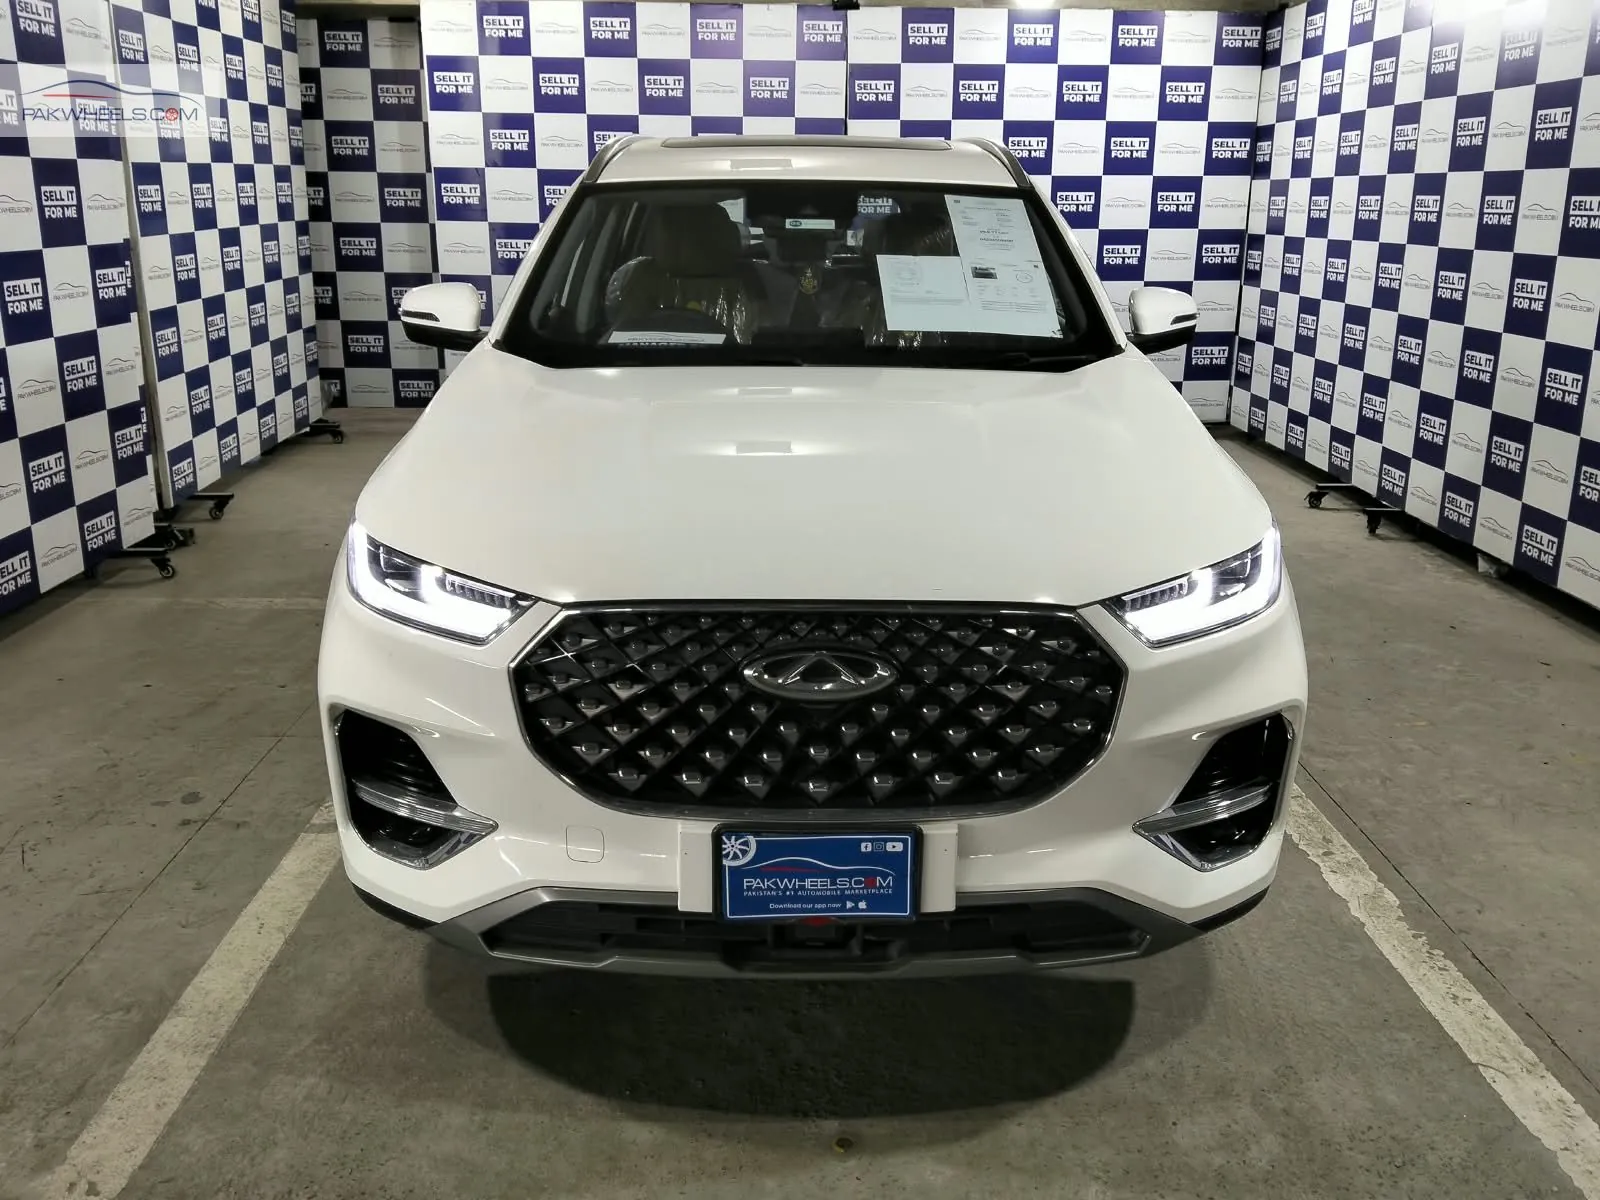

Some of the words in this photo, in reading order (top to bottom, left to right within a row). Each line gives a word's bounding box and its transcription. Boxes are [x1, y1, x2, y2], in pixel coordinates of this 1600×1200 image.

[120, 33, 136, 46] SELL
[136, 37, 142, 47] IT
[121, 47, 135, 60] FOR
[135, 50, 145, 62] ME
[178, 47, 191, 57] SELL
[191, 49, 196, 58] IT
[180, 60, 191, 70] FOR
[191, 61, 200, 71] ME
[1537, 113, 1559, 124] SELL
[1560, 111, 1570, 123] IT
[1395, 128, 1410, 137] SELL
[1410, 127, 1417, 136] IT
[1458, 122, 1476, 132] SELL
[1477, 121, 1485, 131] IT
[1456, 136, 1471, 146] FOR
[1471, 135, 1483, 145] ME
[1534, 129, 1553, 141] FOR
[1554, 127, 1569, 139] ME
[1393, 142, 1406, 151] FOR
[1406, 141, 1416, 151] ME
[43, 190, 65, 201] SELL
[66, 191, 74, 201] IT
[139, 189, 153, 198] SELL
[153, 188, 159, 198] IT
[140, 202, 153, 213] FOR
[152, 202, 162, 212] ME
[1361, 199, 1373, 207] SELL
[1374, 199, 1380, 207] IT
[1485, 199, 1504, 209] SELL
[1505, 200, 1514, 210] IT
[44, 207, 63, 218] FOR
[63, 206, 77, 217] ME
[1482, 214, 1498, 224] FOR
[1498, 214, 1512, 226] ME
[98, 272, 116, 283] SELL
[117, 271, 124, 282] IT
[5, 284, 30, 297] SELL
[31, 282, 40, 294] IT
[99, 287, 114, 300] FOR
[115, 286, 127, 297] ME
[1515, 282, 1536, 294] SELL
[1537, 285, 1546, 296] IT
[7, 301, 27, 314] FOR
[28, 298, 43, 311] ME
[1512, 297, 1530, 309] FOR
[1530, 299, 1544, 311] ME
[157, 332, 170, 343] SELL
[170, 330, 176, 340] IT
[158, 345, 169, 356] FOR
[169, 343, 178, 353] ME
[65, 362, 85, 376] SELL
[86, 360, 93, 371] IT
[1466, 354, 1484, 366] SELL
[1485, 358, 1493, 368] IT
[1463, 367, 1479, 380] FOR
[1479, 371, 1492, 383] ME
[1547, 372, 1569, 387] SELL
[1570, 377, 1580, 389] IT
[66, 378, 83, 392] FOR
[83, 375, 97, 388] ME
[1545, 387, 1562, 400] FOR
[1563, 391, 1578, 405] ME
[1422, 416, 1438, 429] SELL
[1438, 421, 1445, 432] IT
[116, 431, 133, 444] SELL
[135, 428, 141, 439] IT
[1419, 429, 1432, 442] FOR
[1432, 433, 1444, 446] ME
[117, 446, 131, 459] FOR
[132, 442, 143, 454] ME
[1494, 440, 1513, 455] SELL
[1513, 446, 1522, 458] IT
[31, 460, 53, 477] SELL
[54, 456, 62, 469] IT
[174, 464, 186, 478] SELL
[186, 461, 191, 471] IT
[1491, 454, 1507, 468] FOR
[1507, 459, 1520, 473] ME
[32, 476, 50, 492] FOR
[51, 471, 65, 485] ME
[175, 478, 185, 490] FOR
[185, 473, 194, 484] ME
[85, 519, 105, 536] SELL
[106, 515, 113, 527] IT
[87, 535, 103, 551] FOR
[104, 528, 117, 543] ME
[1524, 529, 1545, 546] SELL
[1546, 538, 1556, 550] IT
[1520, 542, 1538, 559] FOR
[1538, 551, 1553, 566] ME
[744, 876, 892, 889] PAKWHEELS.COM
